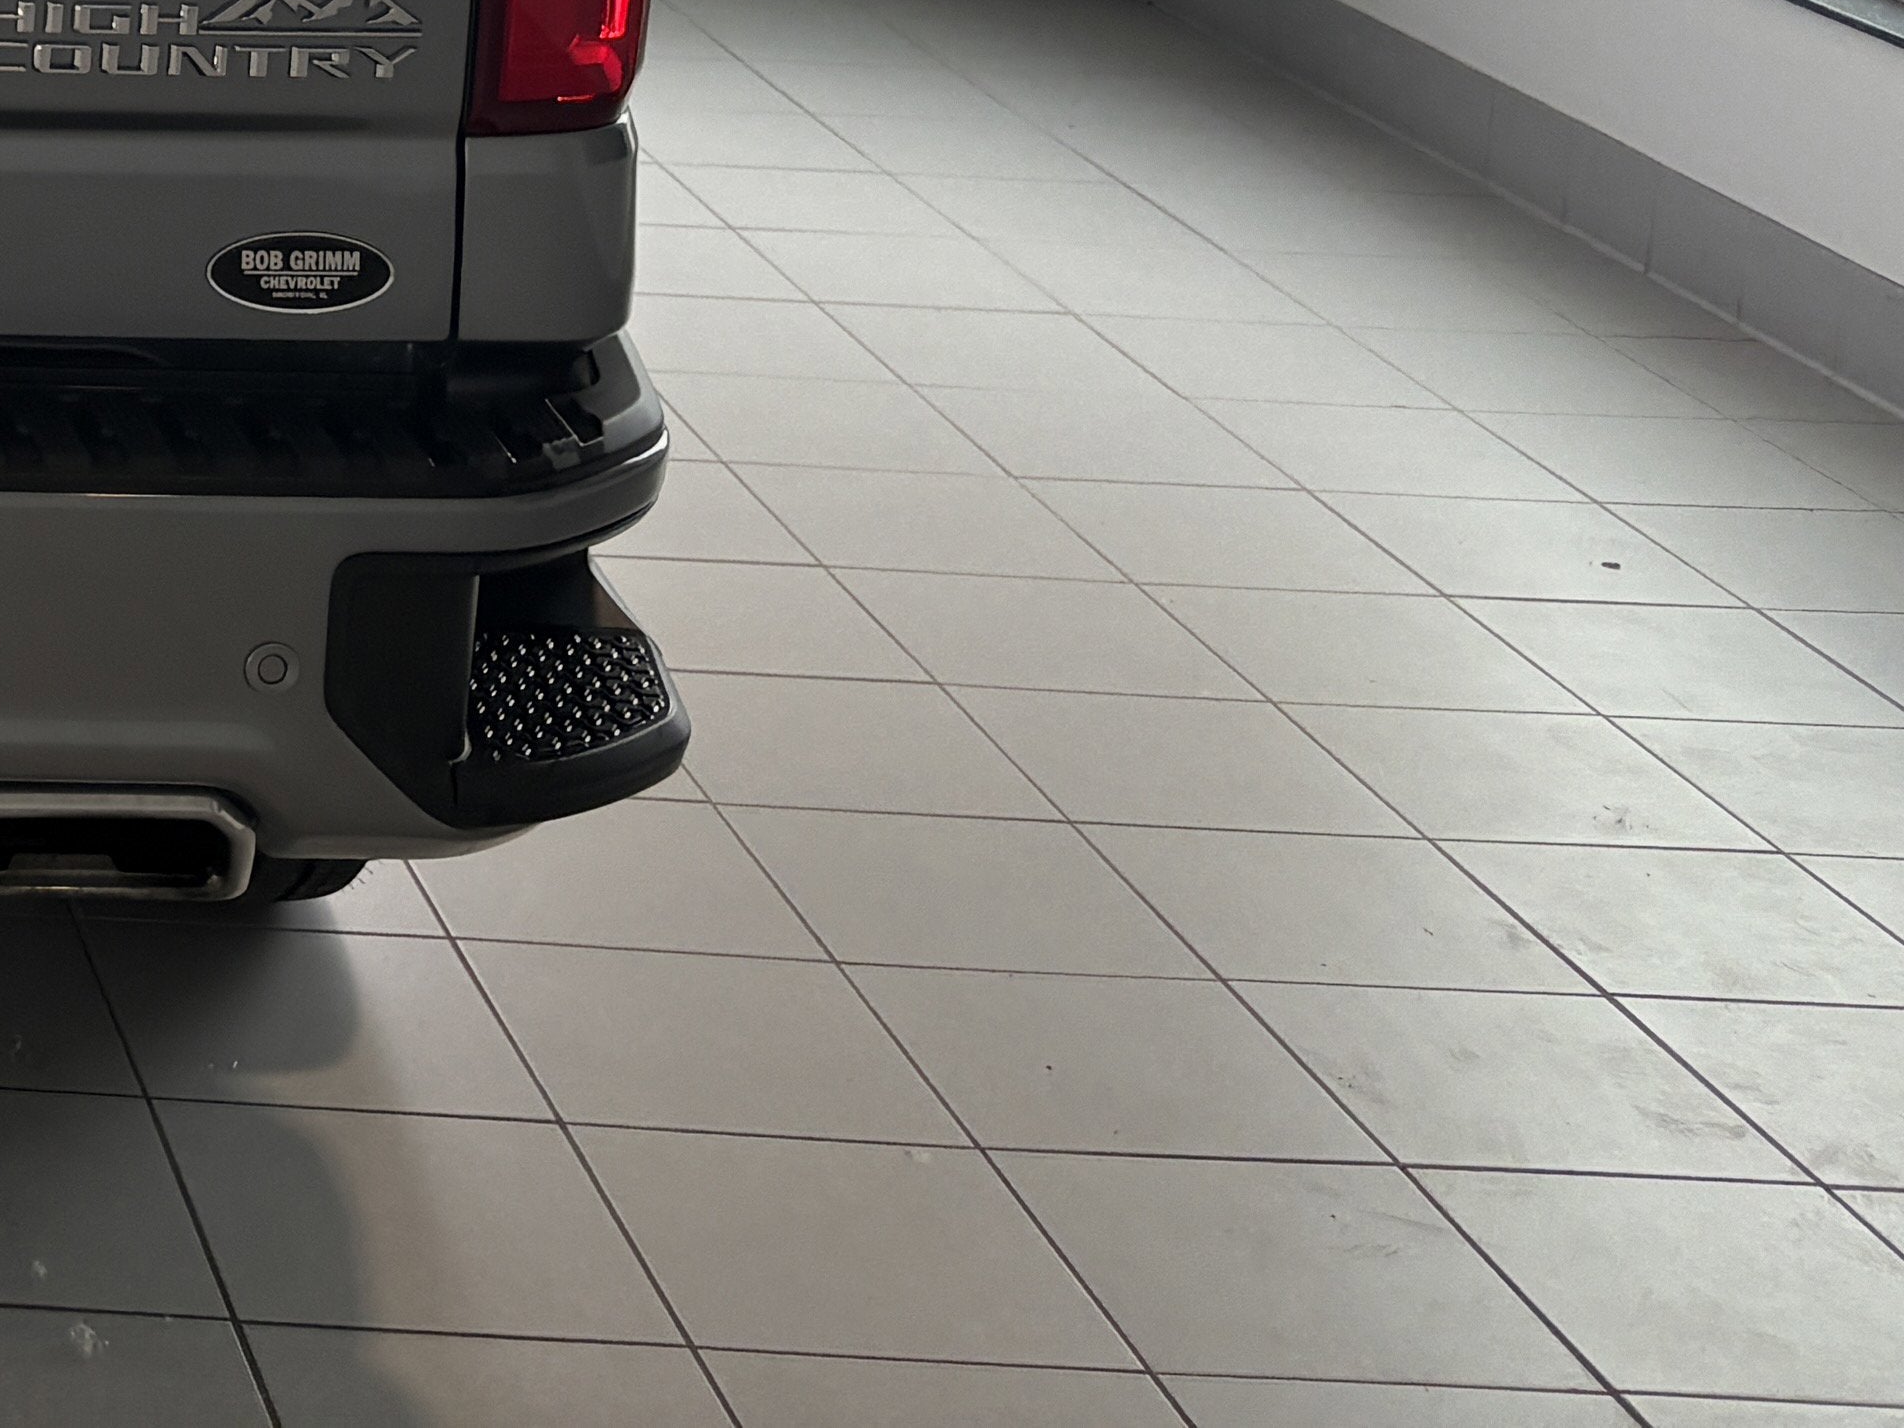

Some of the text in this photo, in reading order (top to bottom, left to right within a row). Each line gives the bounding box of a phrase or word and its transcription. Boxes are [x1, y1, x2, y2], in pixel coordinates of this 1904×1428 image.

[241, 250, 360, 271] BOB GRIMM
[260, 276, 340, 290] CHEVROLET
